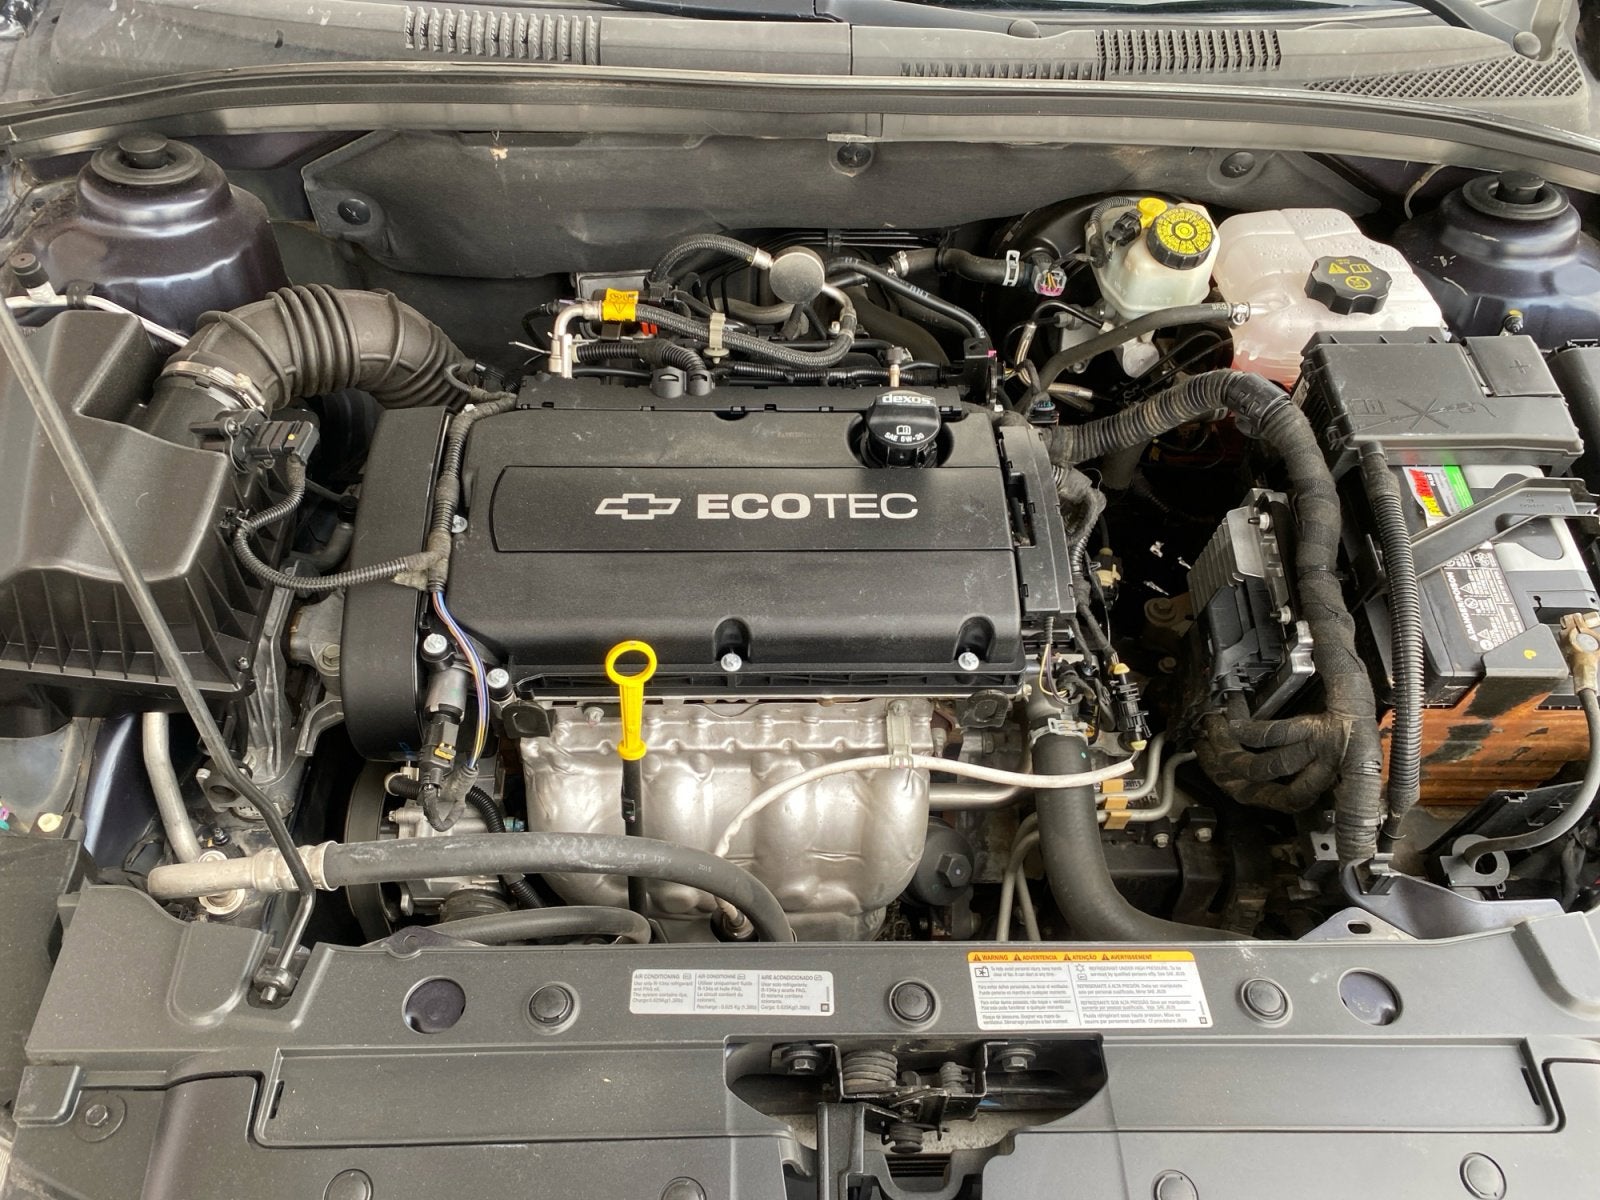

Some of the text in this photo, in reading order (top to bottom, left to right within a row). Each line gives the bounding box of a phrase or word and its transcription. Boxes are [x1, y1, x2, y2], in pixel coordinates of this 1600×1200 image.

[882, 393, 933, 405] dexos
[884, 432, 898, 442] SAE
[698, 493, 918, 519] ECOTEC
[1446, 571, 1476, 636] DANGER/POISON
